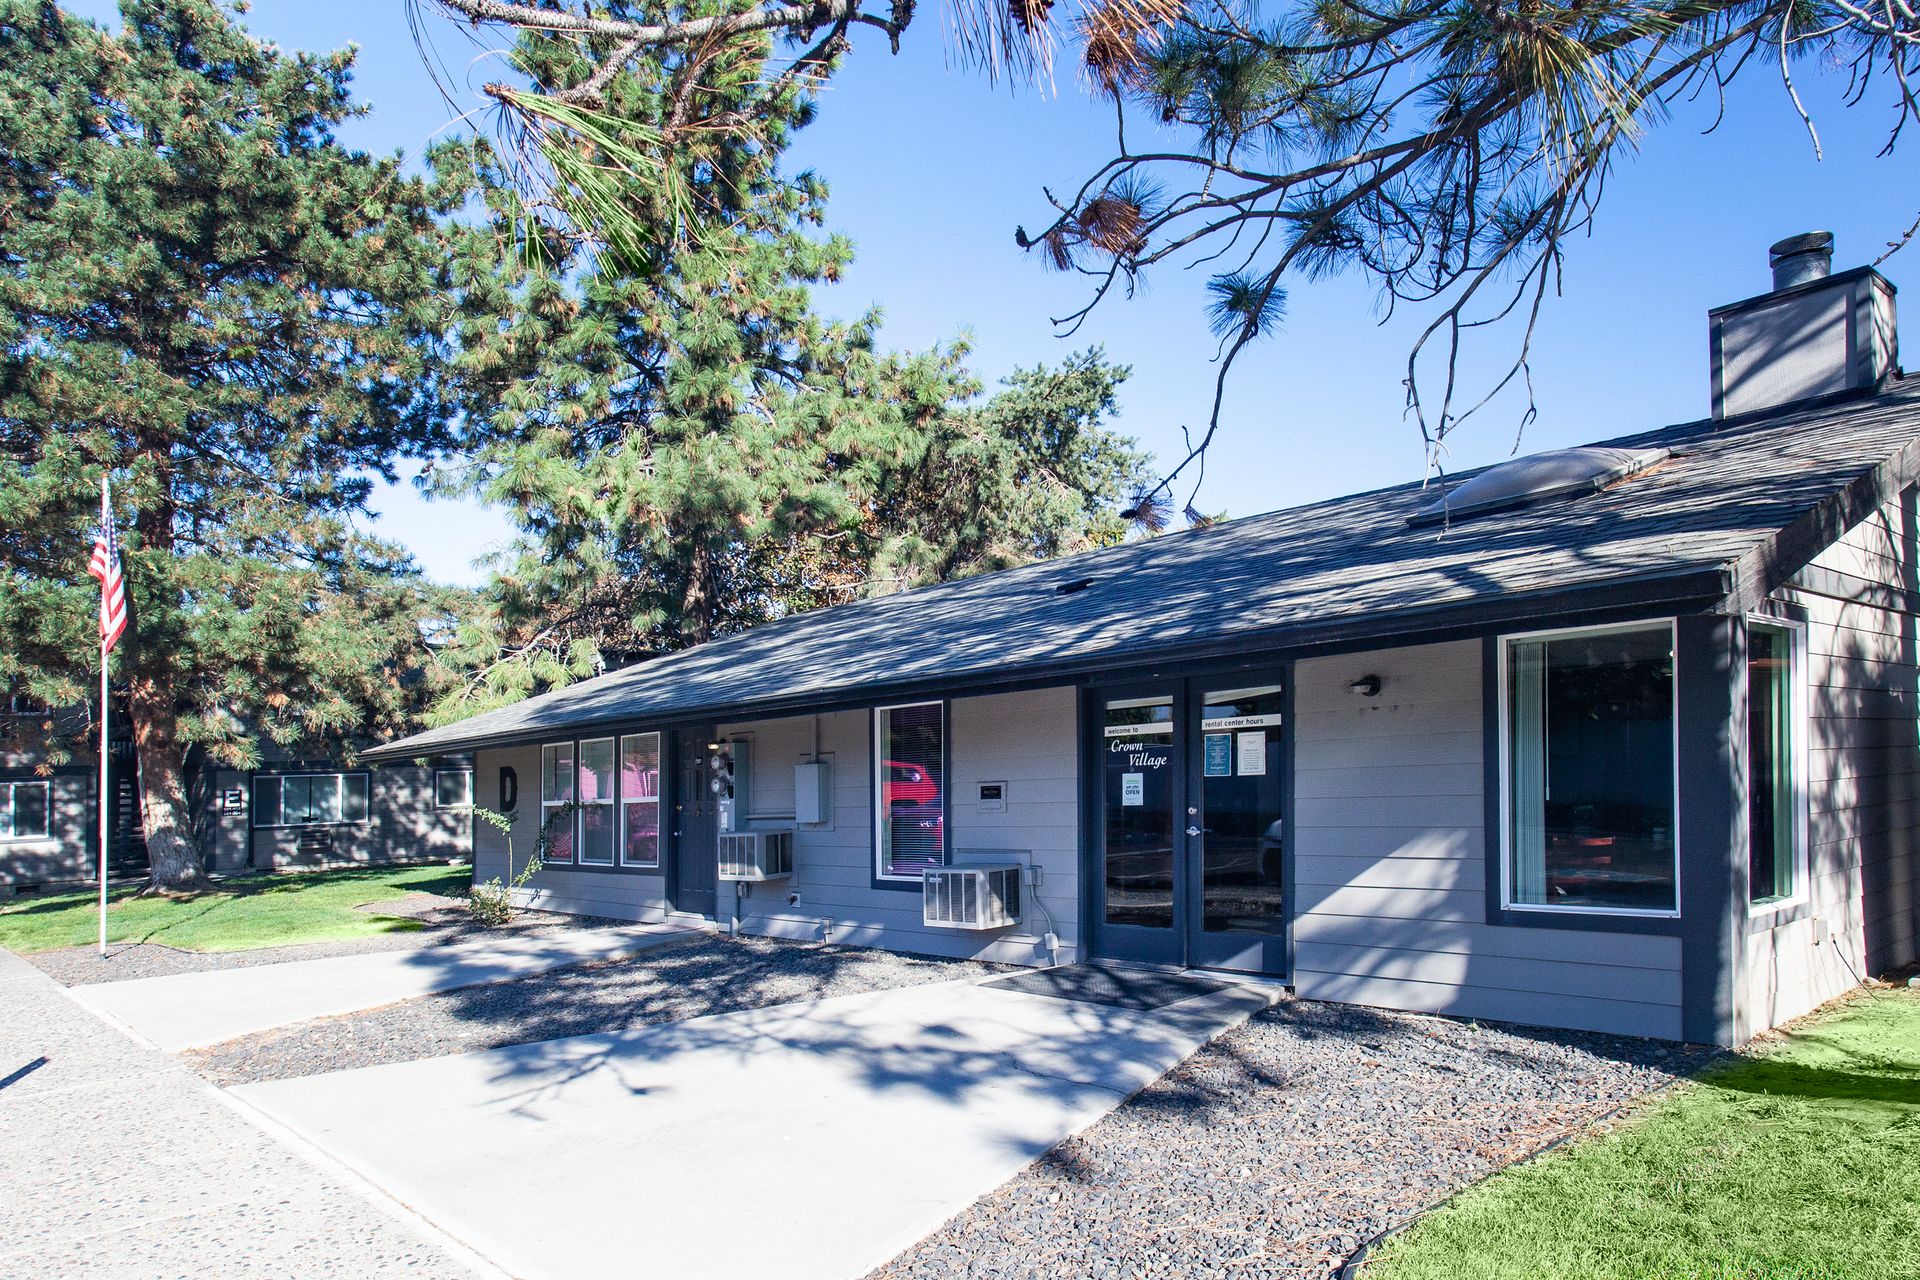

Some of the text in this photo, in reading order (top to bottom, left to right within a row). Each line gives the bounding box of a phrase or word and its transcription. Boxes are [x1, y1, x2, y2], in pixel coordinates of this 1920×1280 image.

[1108, 726, 1139, 735] welcome to
[1111, 739, 1143, 753] Crown
[1129, 752, 1167, 770] Village
[500, 766, 518, 812] D
[224, 790, 240, 807] E
